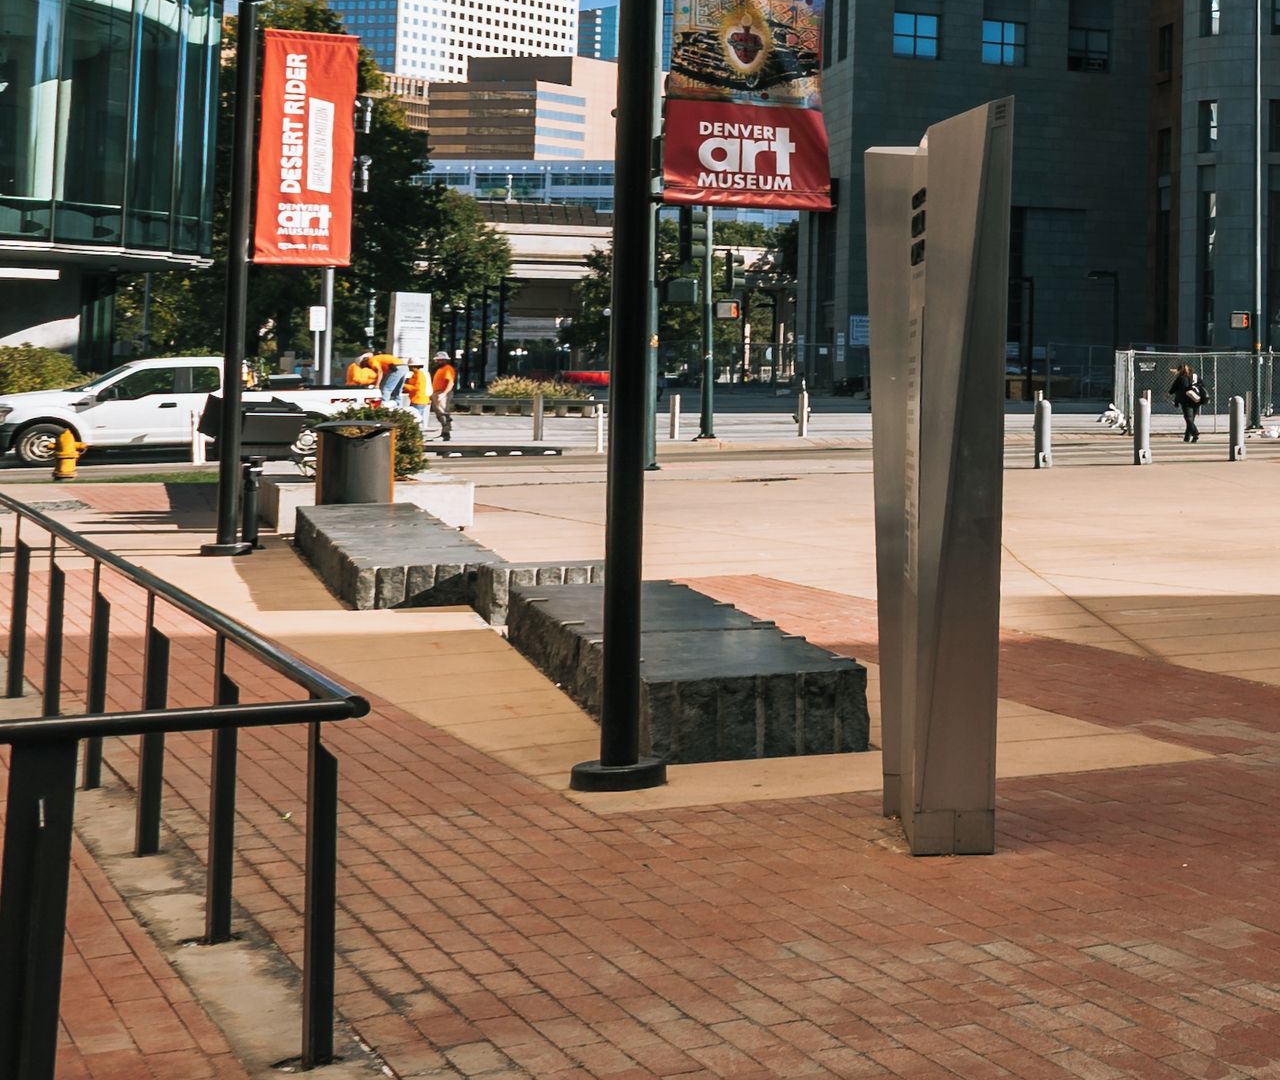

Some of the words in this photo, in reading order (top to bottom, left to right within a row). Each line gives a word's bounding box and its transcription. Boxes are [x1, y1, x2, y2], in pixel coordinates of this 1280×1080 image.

[283, 53, 307, 115] RIDER
[699, 121, 775, 140] DENVER
[280, 117, 304, 194] DESERT
[698, 127, 796, 176] art
[697, 172, 793, 191] MUSEUM
[277, 204, 333, 229] art
[278, 203, 320, 212] DENVER
[276, 227, 330, 237] MUSEUM
